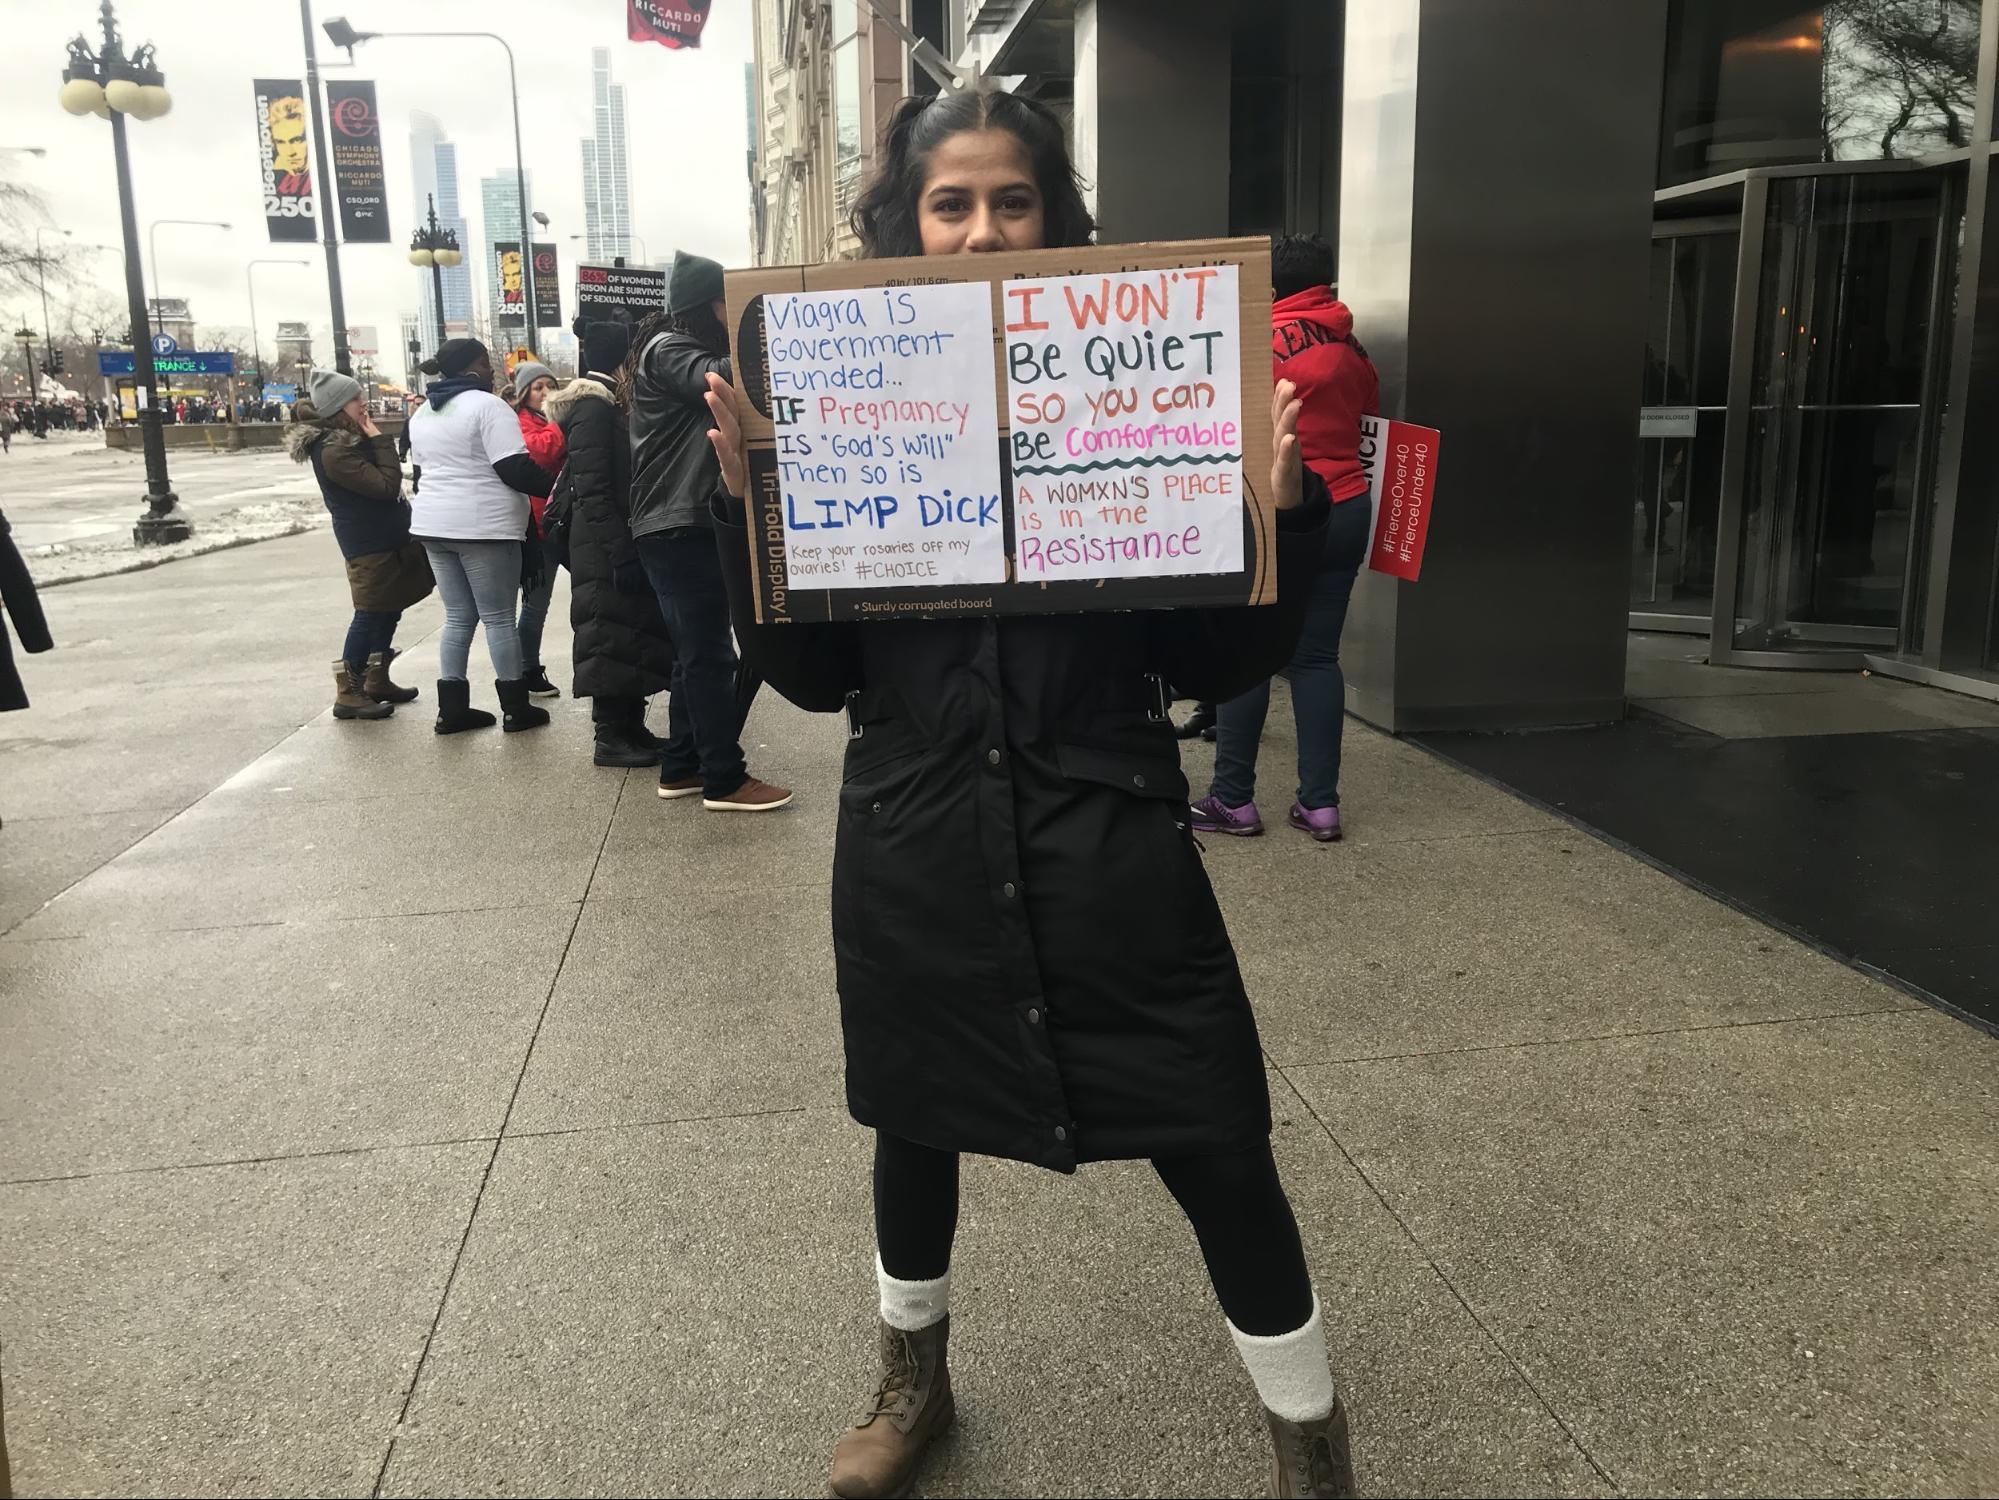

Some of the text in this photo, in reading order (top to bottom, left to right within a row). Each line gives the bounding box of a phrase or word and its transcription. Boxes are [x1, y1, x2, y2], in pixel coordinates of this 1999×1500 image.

[635, 0, 701, 23] RICCARDO
[652, 16, 681, 32] MUTI
[257, 95, 277, 195] Beethoven
[265, 196, 315, 218] 250
[578, 283, 607, 292] RISON
[608, 286, 625, 294] ARE
[583, 270, 665, 286] 86% OF WOMEN IN
[499, 303, 526, 314] 250
[580, 294, 593, 302] OF
[593, 295, 626, 304] SEXUAL
[1006, 269, 1218, 332] I WON'T
[768, 297, 867, 331] Viagra
[158, 338, 171, 352] P
[153, 361, 197, 371] TRANCE
[1009, 342, 1067, 384] Be
[1152, 382, 1215, 413] can
[772, 396, 969, 436] IF Pregnancy
[777, 434, 813, 455] IS
[1012, 430, 1056, 461] Be
[1359, 420, 1378, 490] NCE
[778, 461, 846, 483] Then
[1018, 473, 1232, 504] A WOMXN'S PLACE
[1383, 444, 1410, 553] #FierceOver40
[787, 493, 898, 530] LIMP
[1399, 443, 1428, 563] #FierceUnder40
[1098, 505, 1148, 525] the
[791, 544, 822, 561] Keep
[828, 544, 855, 560] your
[863, 540, 915, 556] rosaries
[949, 539, 971, 556] my
[1021, 525, 1202, 573] Resistance
[767, 547, 789, 614] Display
[789, 560, 939, 580] ovaries! #CHOICE
[898, 599, 957, 613] corrugated
[959, 597, 993, 609] board
